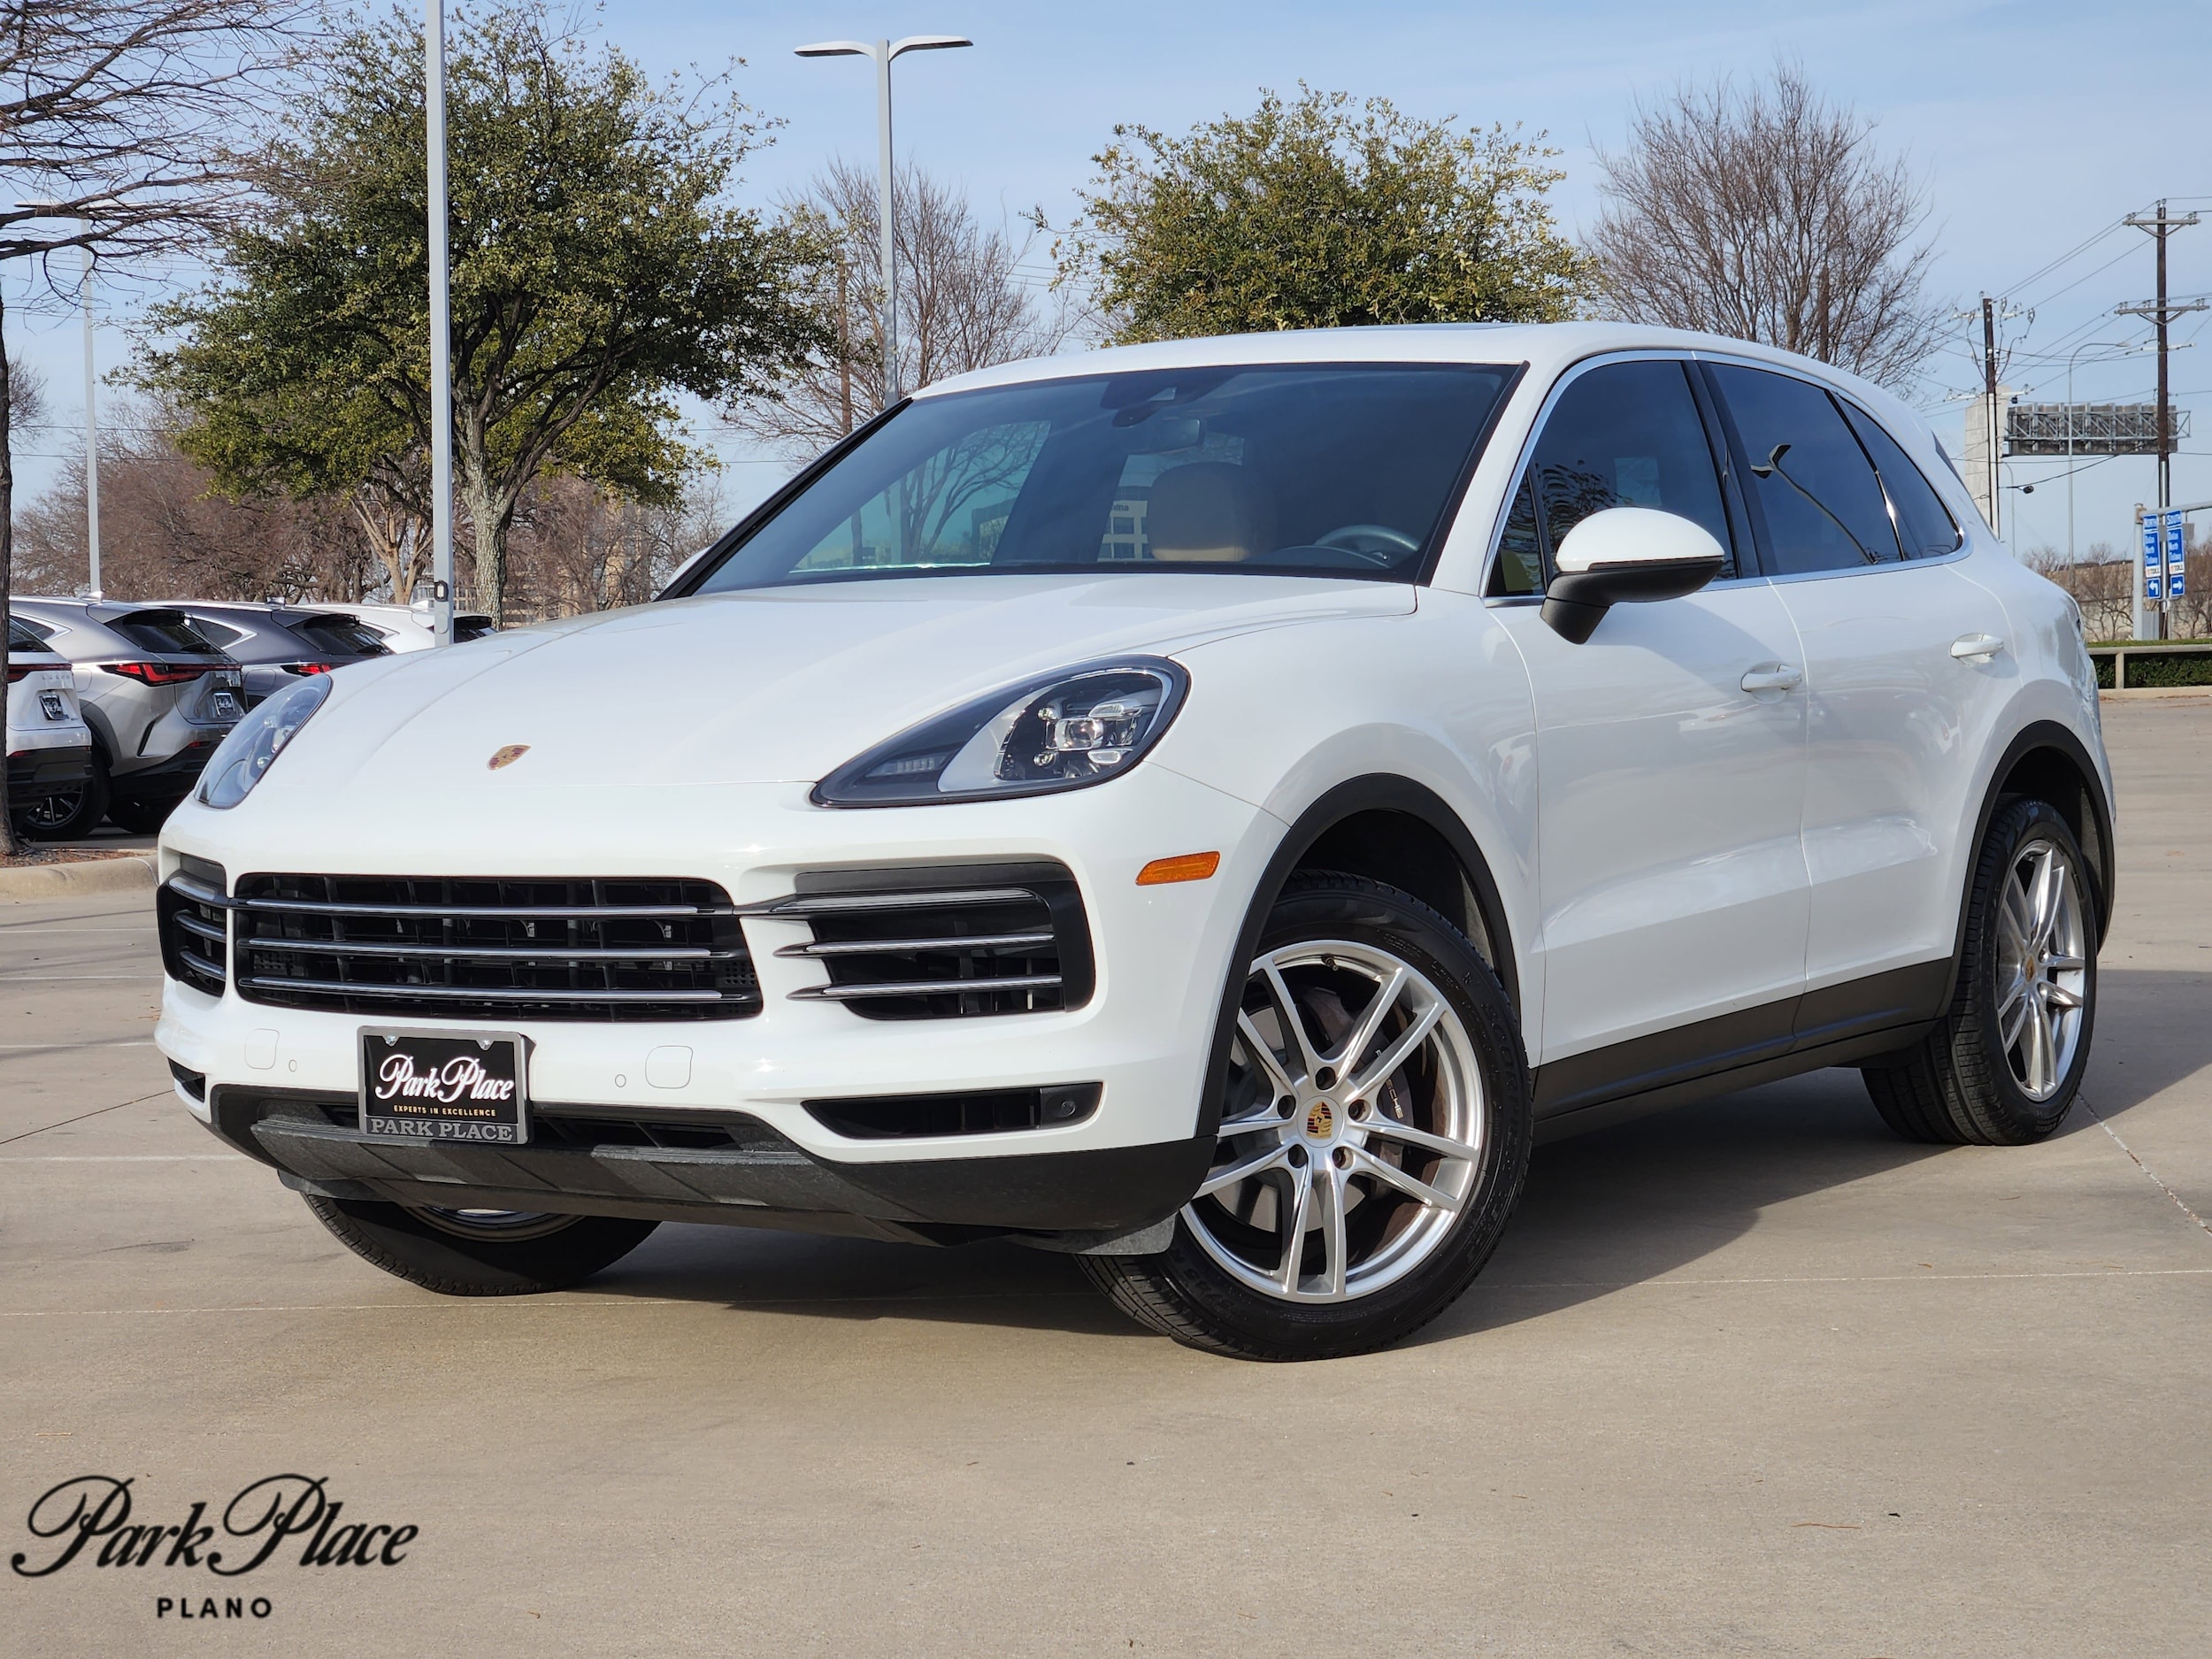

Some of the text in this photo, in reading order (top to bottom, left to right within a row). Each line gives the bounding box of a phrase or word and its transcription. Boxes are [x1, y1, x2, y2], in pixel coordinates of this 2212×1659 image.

[374, 1054, 515, 1103] Park Place
[394, 1105, 496, 1117] EXPERTS IN EXCELLENCE
[371, 1118, 513, 1141] PARK PLACE
